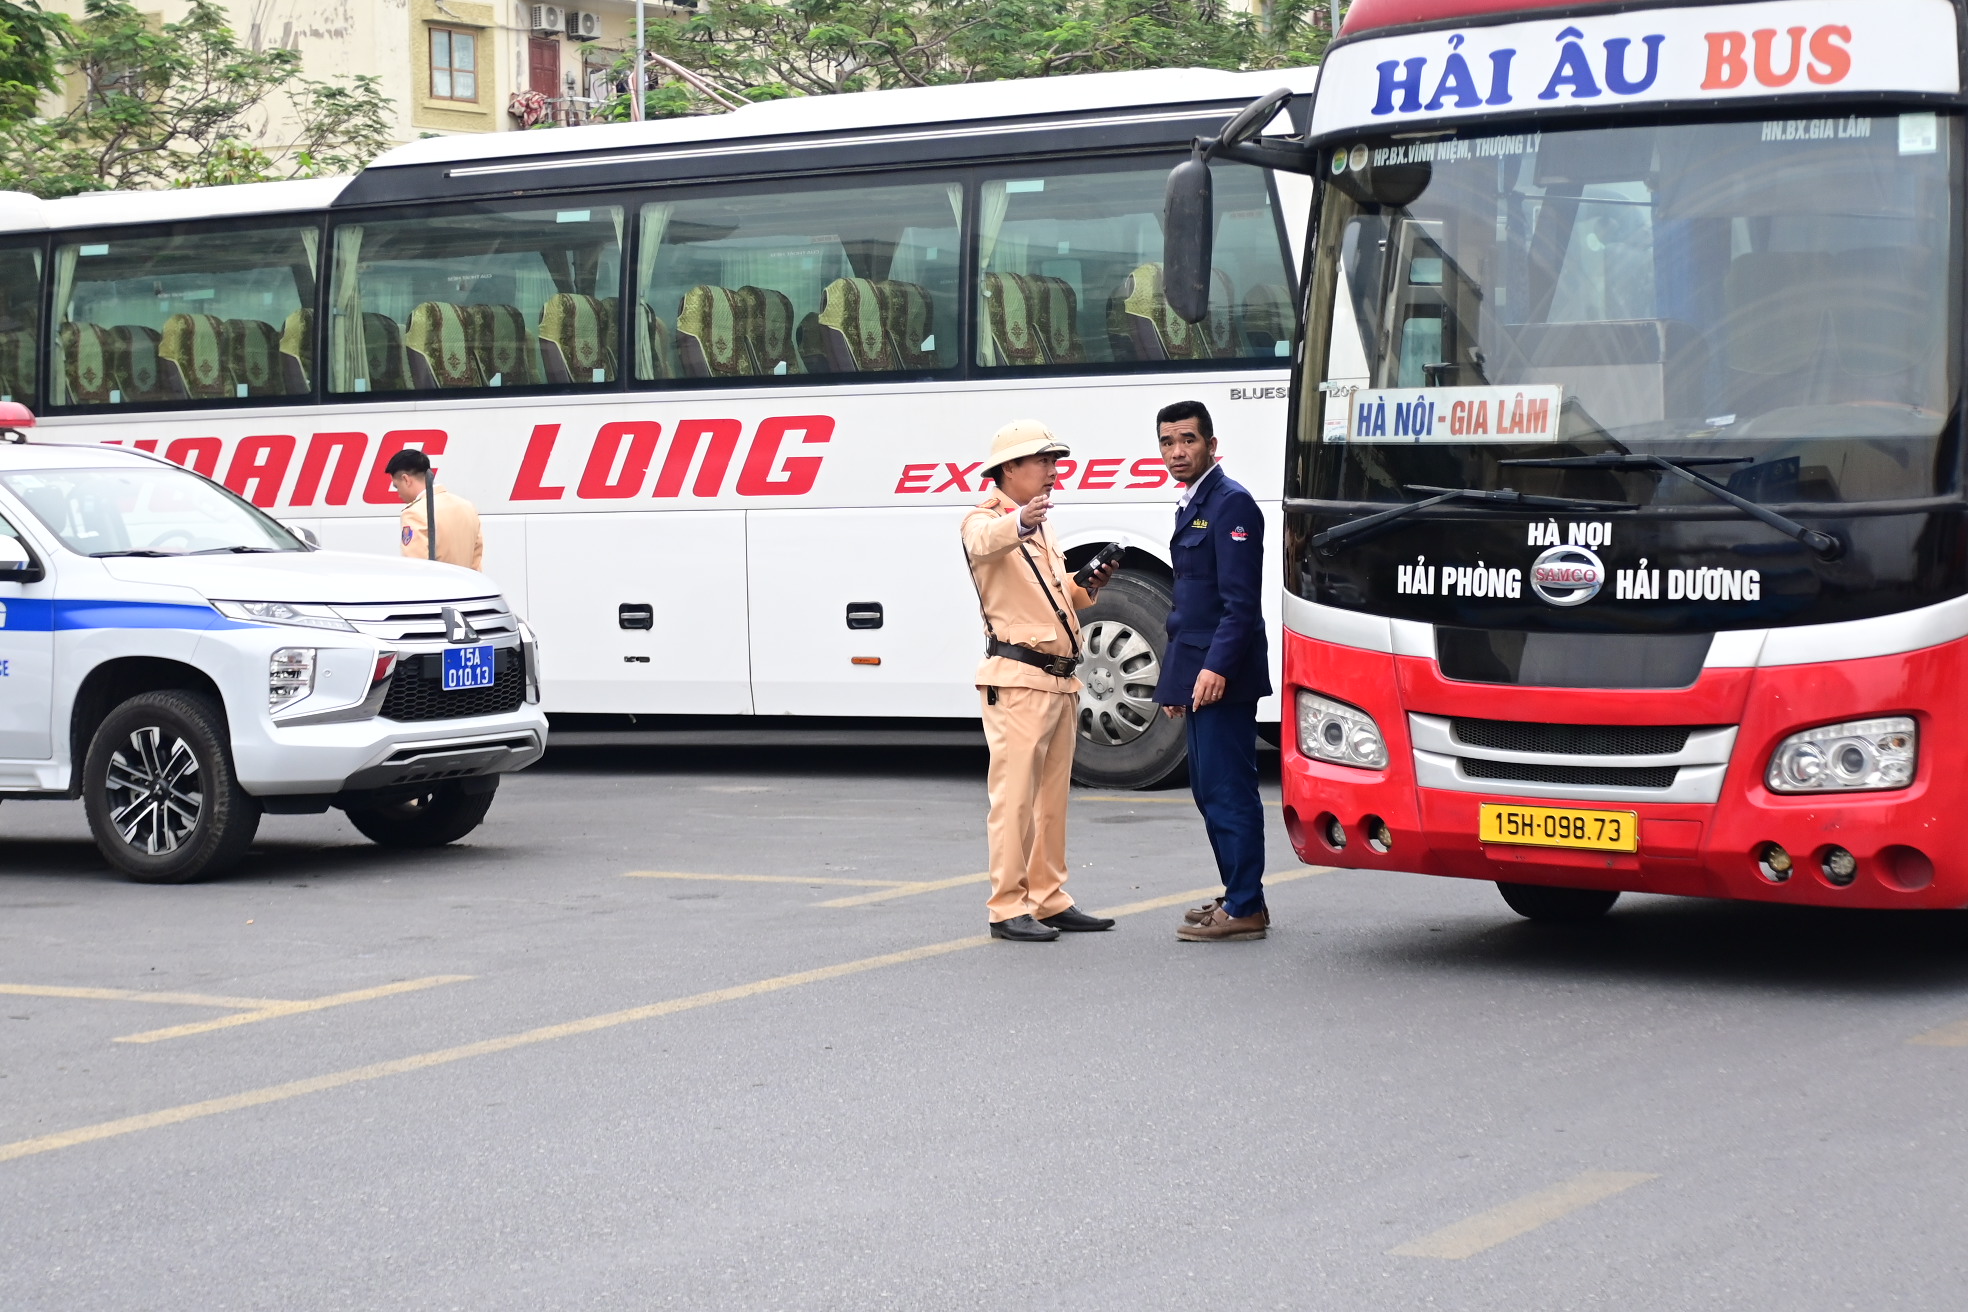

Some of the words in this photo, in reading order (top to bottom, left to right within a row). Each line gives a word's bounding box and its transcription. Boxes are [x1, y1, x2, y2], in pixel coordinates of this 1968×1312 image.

[1371, 33, 1517, 116] HẢI
[1537, 26, 1666, 100] ÂU
[1700, 24, 1852, 91] BUS
[1525, 131, 1542, 153] LÝ
[1761, 118, 1835, 142] HN.BX.GIA
[1838, 114, 1872, 138] LÂM
[1230, 387, 1290, 400] BLUES
[1356, 396, 1386, 437] HÀ
[1394, 395, 1435, 443] NỘI
[1450, 400, 1488, 436] GIA
[1496, 392, 1550, 435] LÂM
[100, 429, 448, 507] OANG
[509, 415, 836, 501] LONG
[1527, 518, 1561, 546] HÀ
[1397, 554, 1435, 595] HẢI
[1441, 561, 1522, 599] PHÒNG
[1535, 566, 1597, 584] SAMCO
[1616, 557, 1660, 600] HẢI
[1667, 566, 1761, 601] DƯƠNG
[460, 648, 481, 667] 15A
[448, 666, 489, 687] 010.13
[1495, 812, 1621, 842] 15H-098.73
